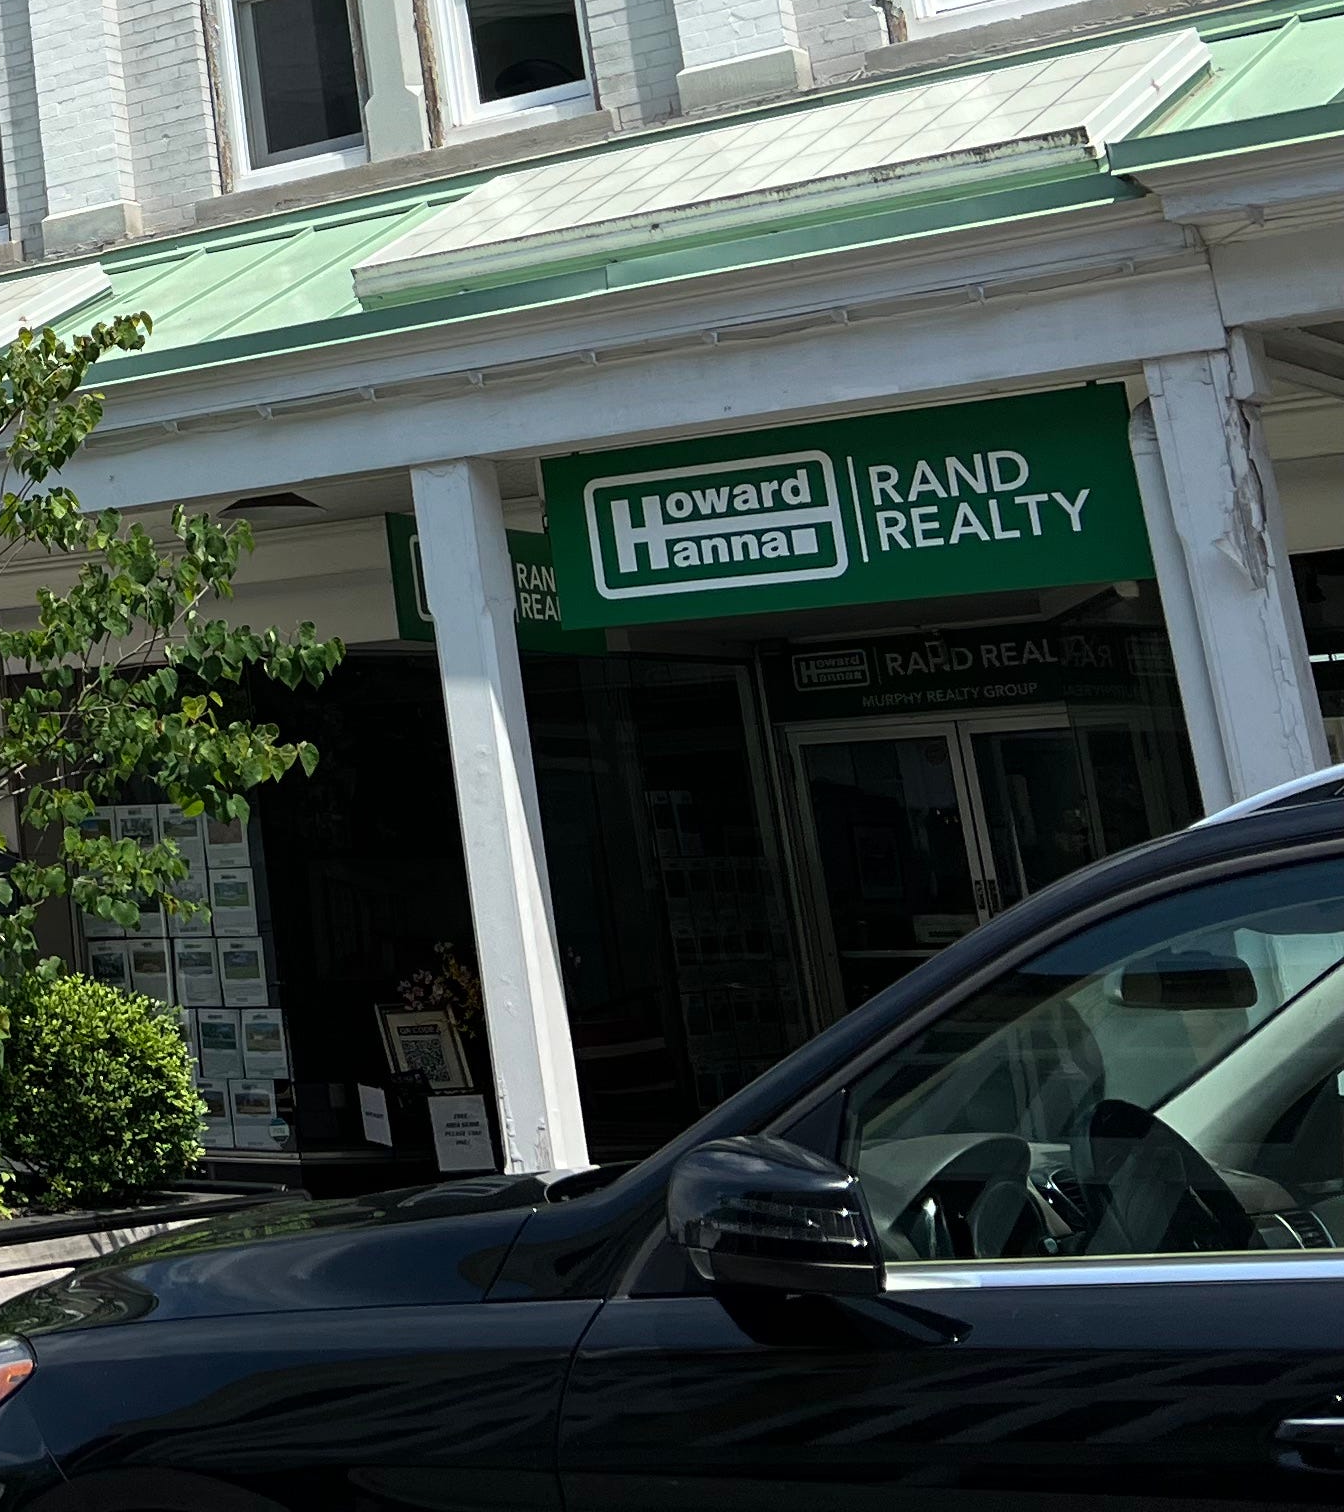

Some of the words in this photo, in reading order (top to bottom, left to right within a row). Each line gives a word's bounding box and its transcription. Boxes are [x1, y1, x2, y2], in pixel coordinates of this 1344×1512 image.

[867, 449, 1030, 506] RAND
[874, 488, 1091, 553] REALTY
[515, 562, 557, 593] RAN
[979, 638, 1059, 670] REAL
[862, 691, 923, 709] MURPHY
[926, 686, 980, 702] REALTY
[983, 682, 1040, 698] GROUP
